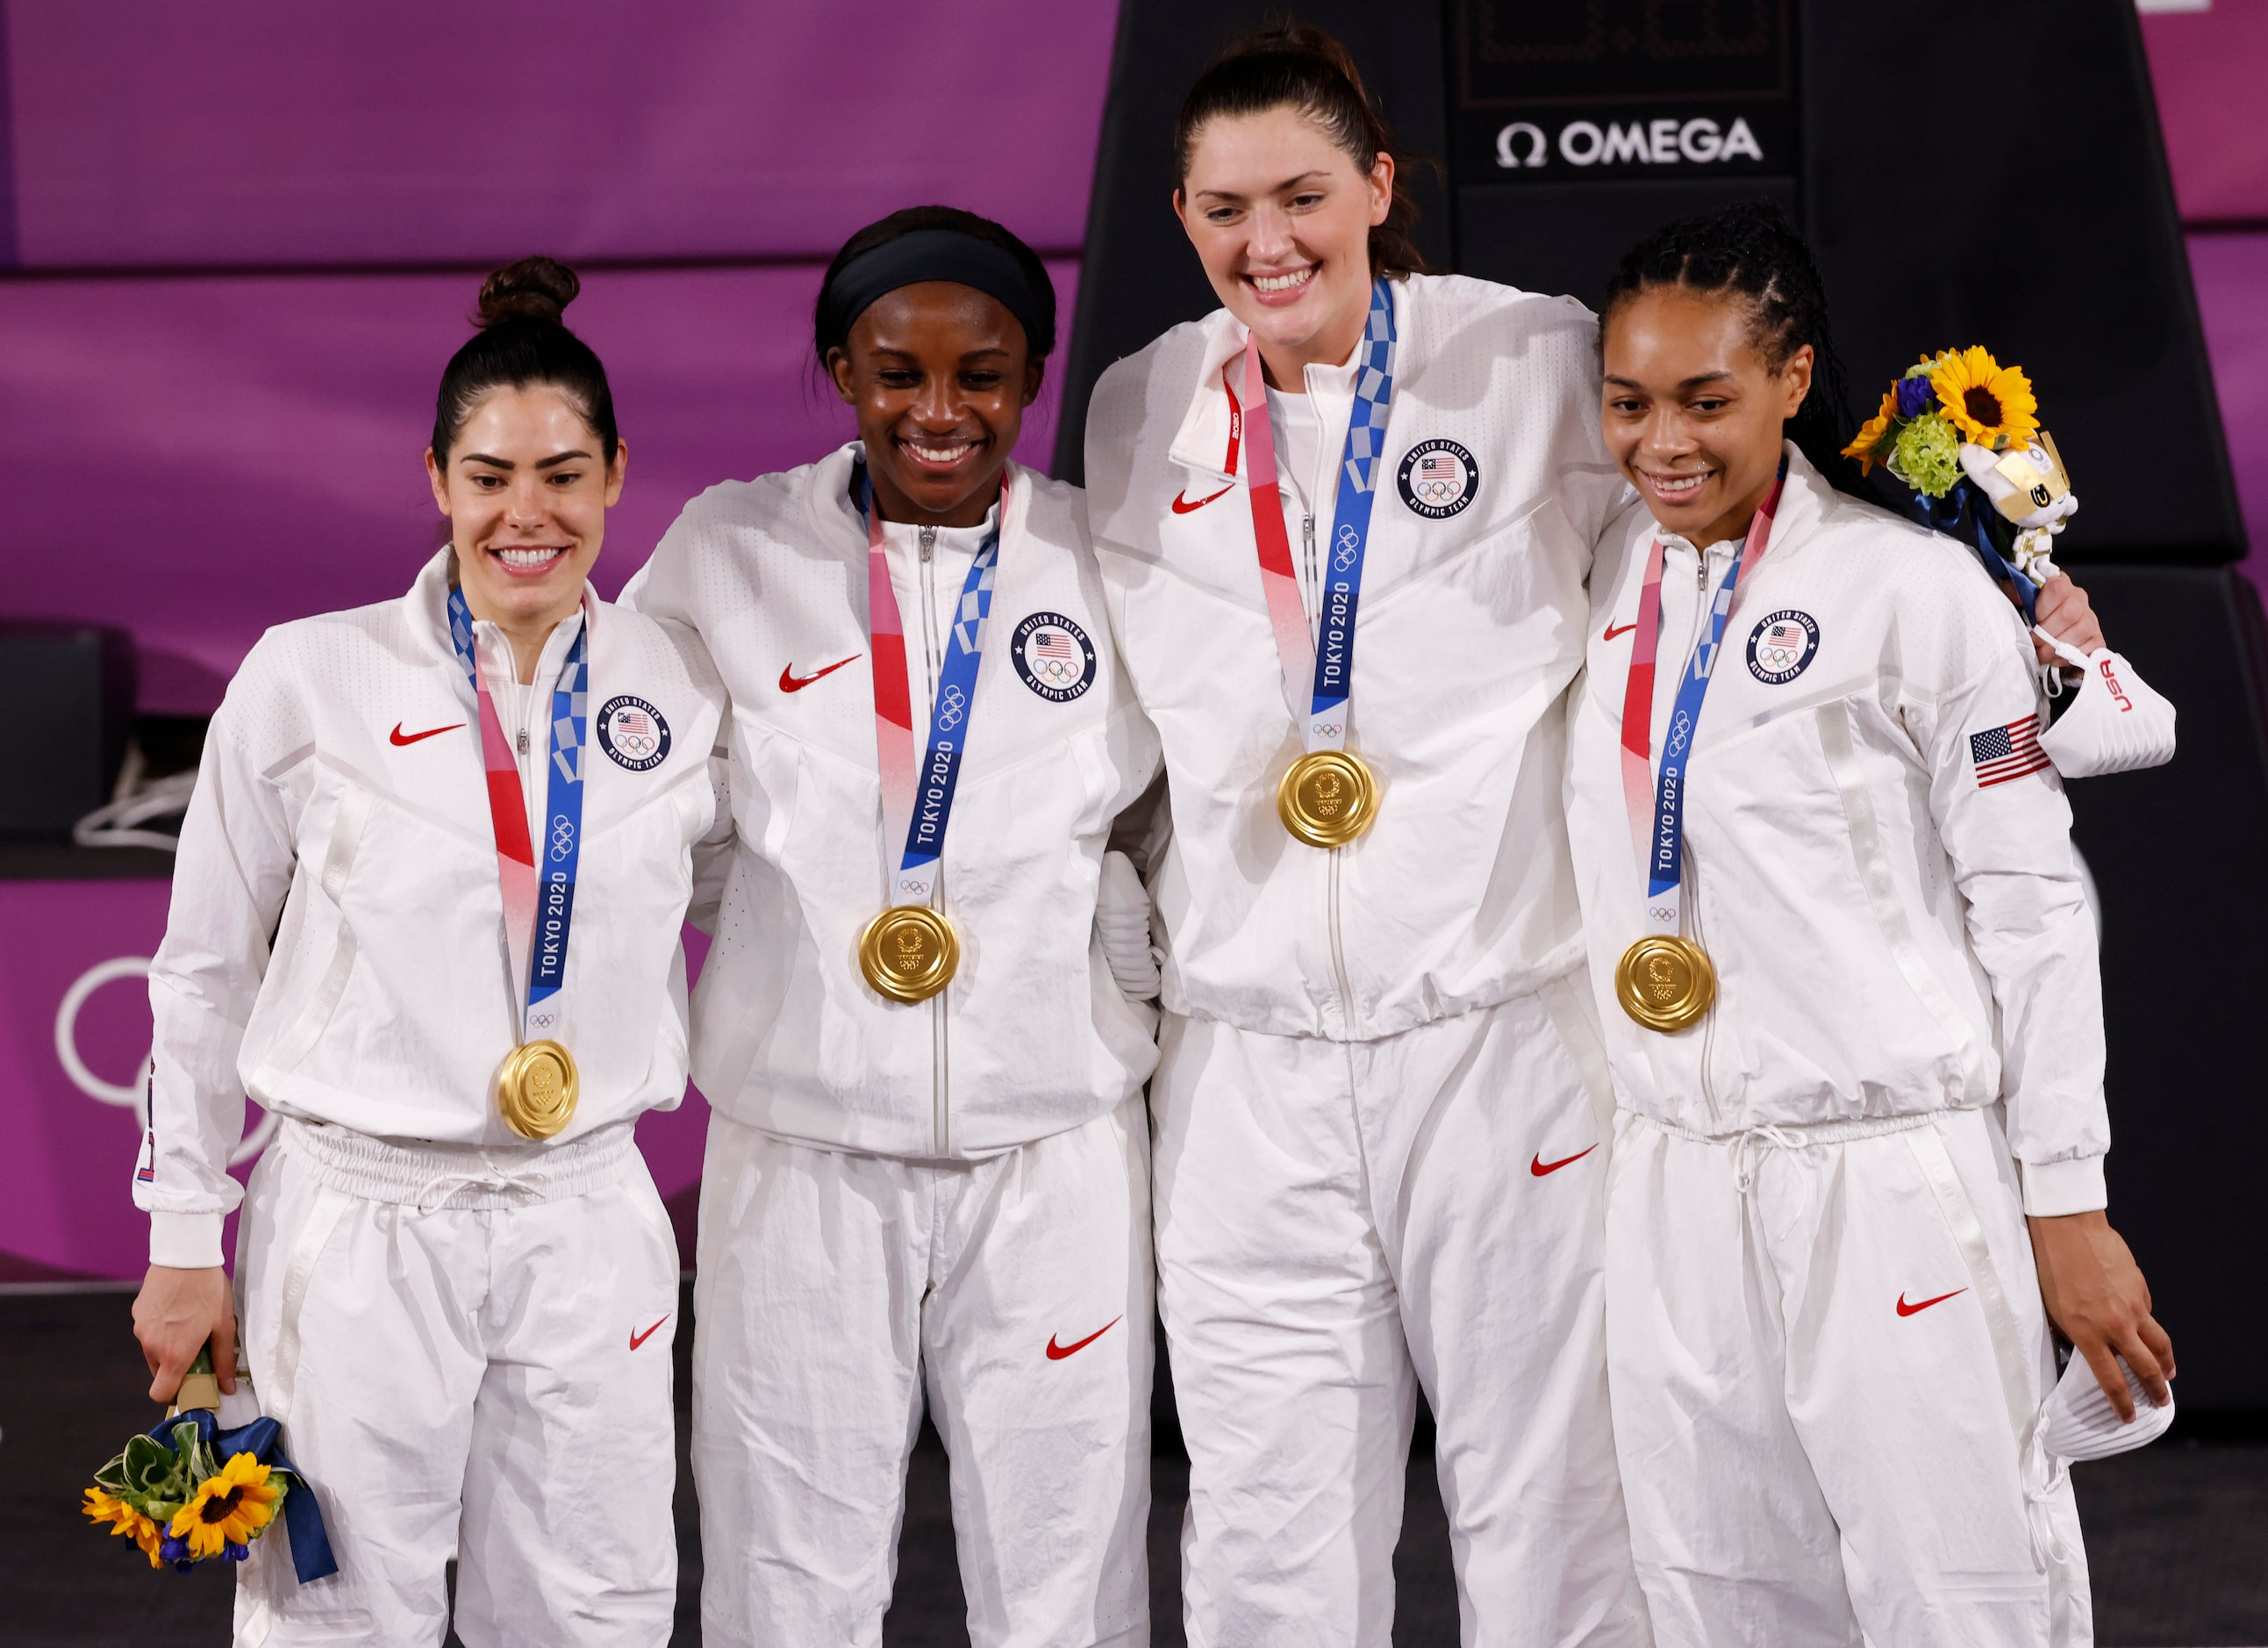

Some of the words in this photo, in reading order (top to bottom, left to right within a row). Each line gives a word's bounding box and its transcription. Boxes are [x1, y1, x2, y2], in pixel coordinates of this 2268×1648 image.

[1558, 117, 1764, 166] OMEGA
[1406, 441, 1436, 463] UNITED
[1440, 441, 1470, 462] STATES
[1409, 497, 1446, 516] OLYMPIC
[1449, 496, 1470, 514] TEAM
[1330, 581, 1350, 627] 2020
[1761, 611, 1792, 628] UNITED
[1793, 612, 1816, 634] STATES
[1020, 614, 1049, 636] UNITED
[1053, 615, 1086, 641] STATES
[1323, 630, 1344, 688] TOKYO
[1749, 660, 1778, 683] OLYMPIC
[1780, 665, 1801, 682] TEAM
[605, 697, 630, 715] UNITED
[633, 699, 661, 720] STATES
[1026, 674, 1064, 700] OLYMPIC
[1067, 680, 1089, 699] TEAM
[2099, 659, 2133, 713] USA
[608, 747, 642, 770] OLYMPIC
[645, 751, 664, 768] TEAM
[930, 740, 954, 786] 2020
[1663, 766, 1678, 811] 2020
[917, 787, 944, 844] TOKYO
[1658, 813, 1675, 871] TOKYO
[547, 871, 568, 916] 2020
[540, 920, 562, 978] TOKYO
